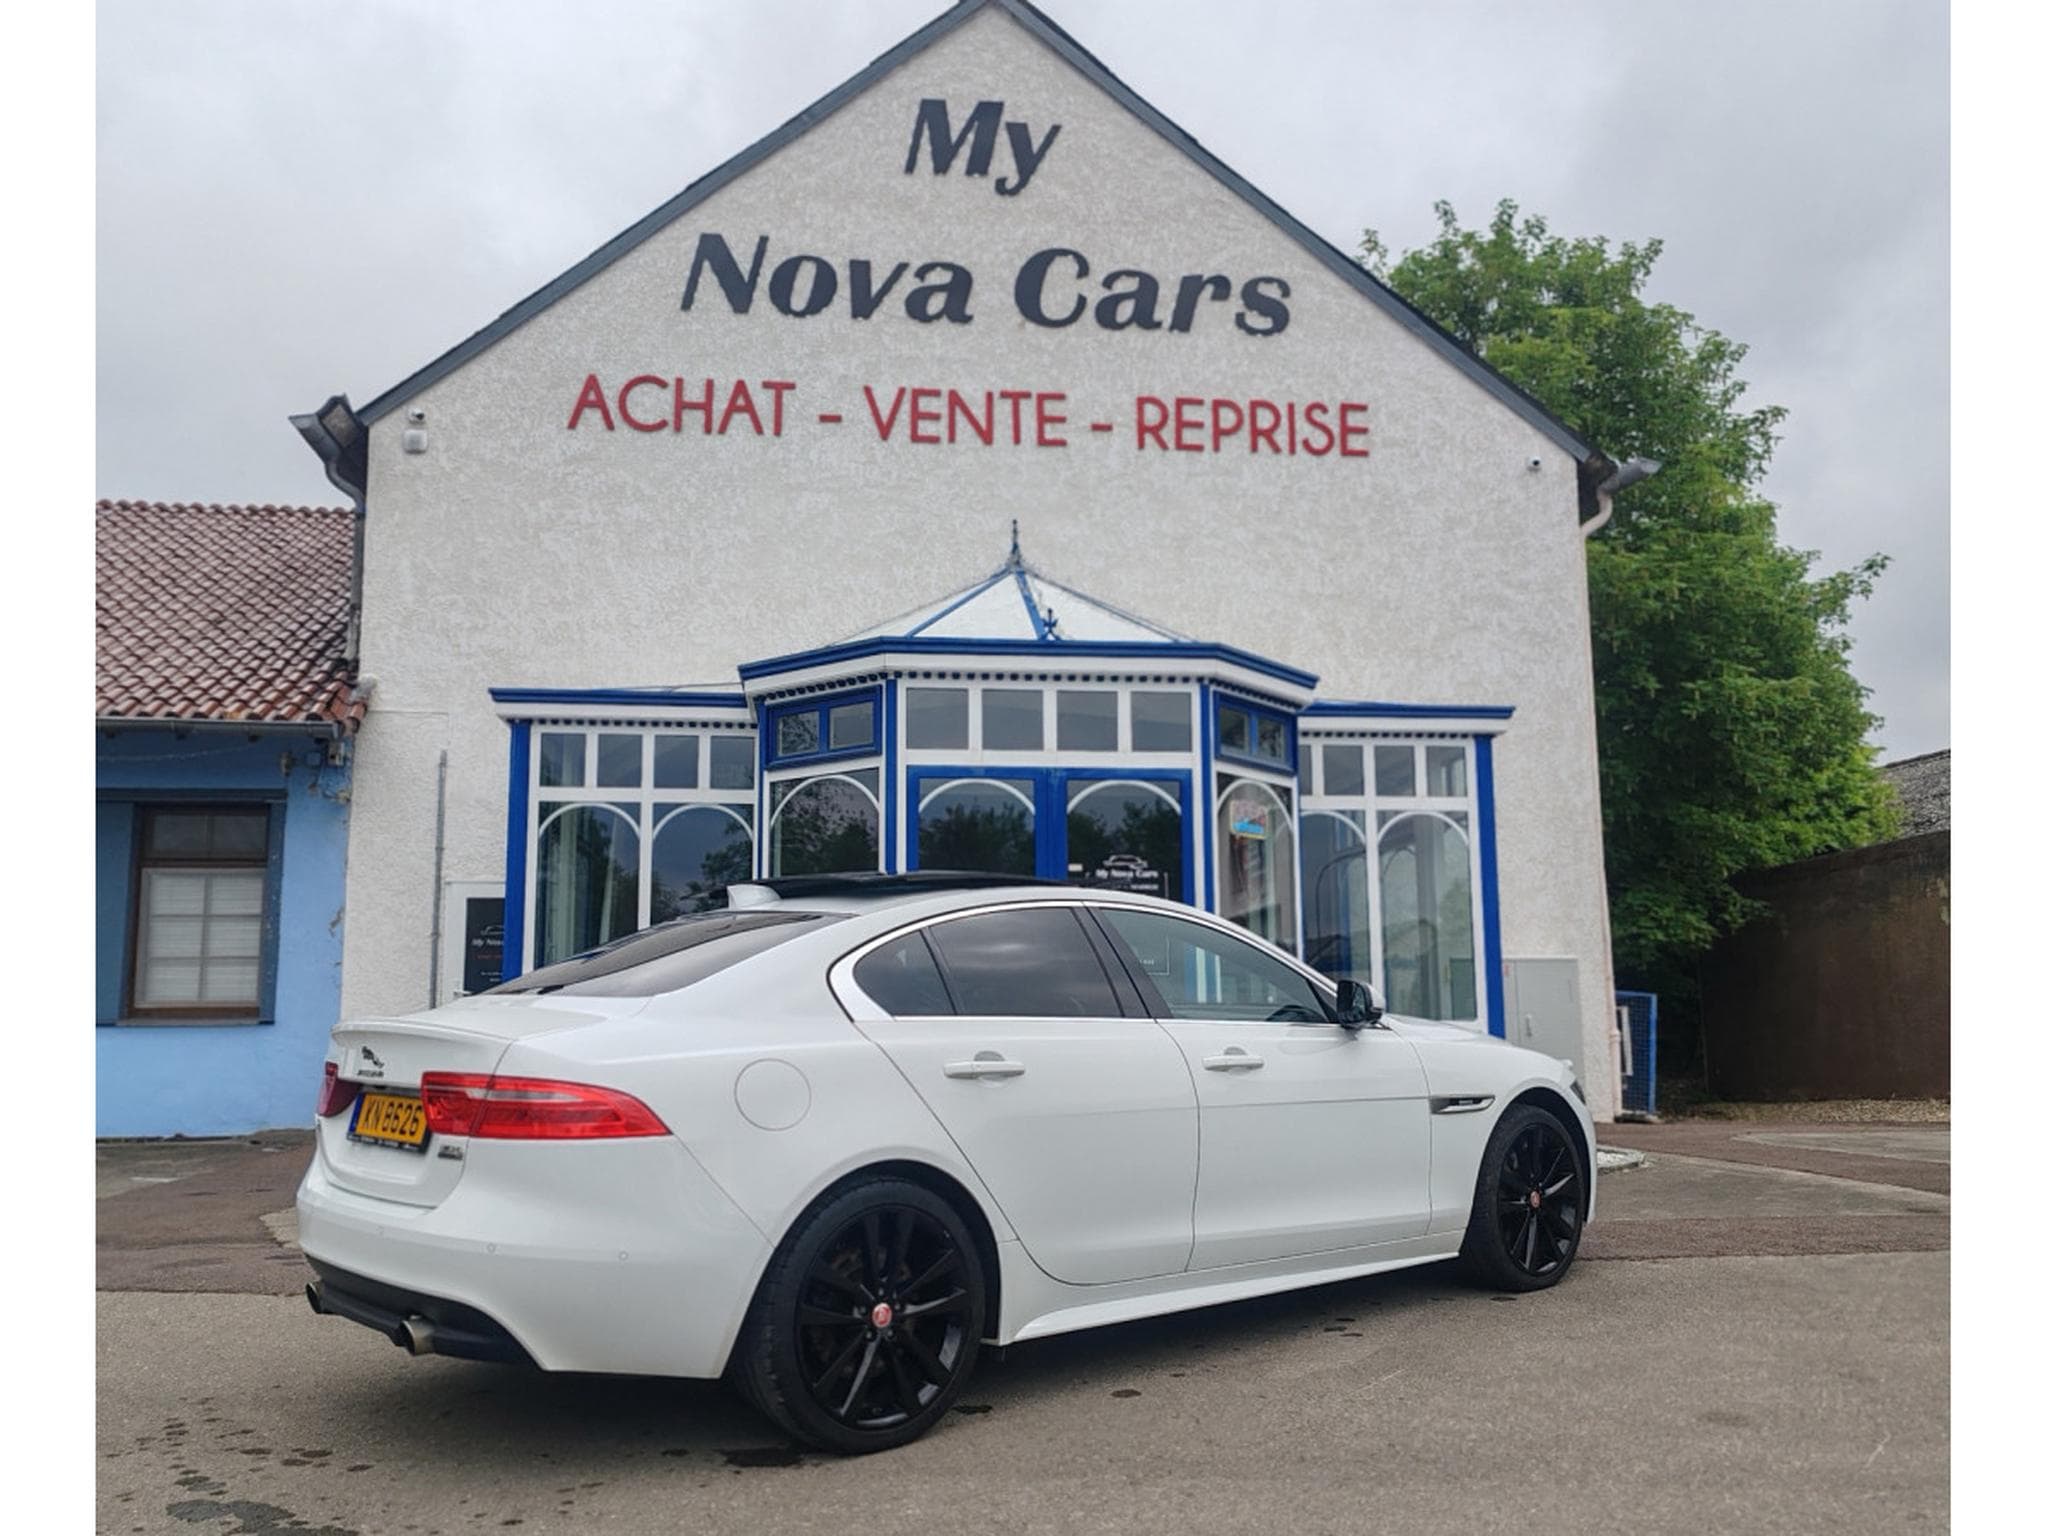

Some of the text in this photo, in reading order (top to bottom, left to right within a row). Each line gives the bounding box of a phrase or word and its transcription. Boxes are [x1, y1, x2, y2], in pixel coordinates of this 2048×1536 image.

[904, 98, 1062, 197] My
[680, 233, 1292, 337] Nova Cars
[567, 373, 796, 435] ACHAT
[862, 385, 1068, 447] VENTE
[1135, 395, 1370, 457] REPRISE
